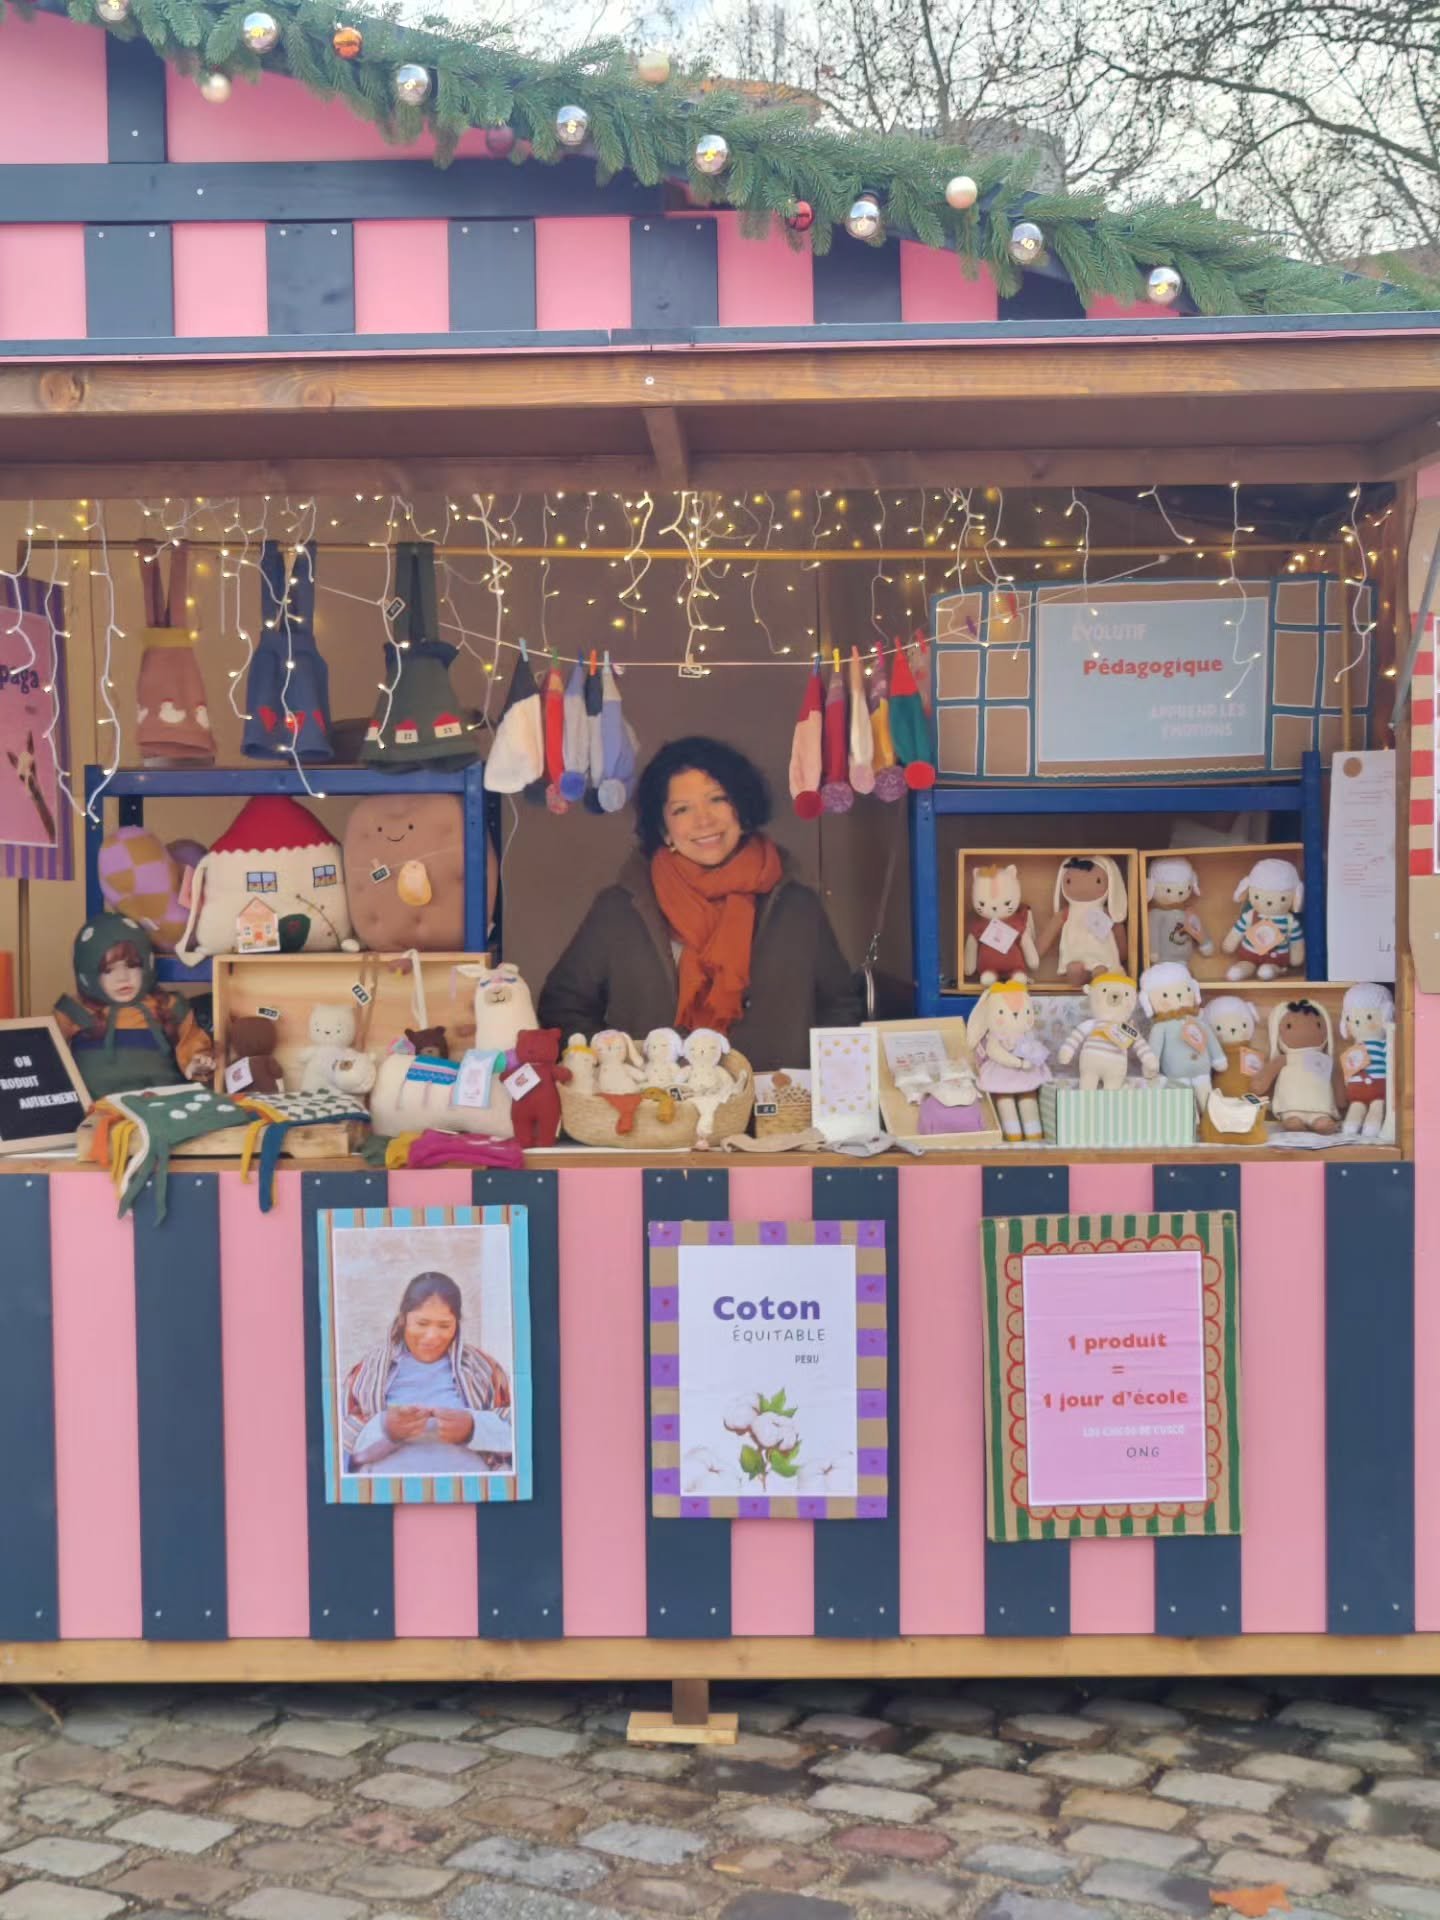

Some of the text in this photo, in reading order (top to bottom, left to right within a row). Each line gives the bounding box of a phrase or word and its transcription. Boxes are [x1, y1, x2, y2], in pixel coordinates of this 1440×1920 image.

[1083, 658, 1224, 679] Pédagogique
[14, 1056, 32, 1068] ON
[19, 1091, 78, 1110] AUTREMENT
[713, 1296, 820, 1320] Coton
[732, 1325, 825, 1342] ÉQUITABLE
[1068, 1332, 1167, 1354] 1 produit
[1043, 1394, 1052, 1409] 1
[1059, 1391, 1104, 1412] jour
[1126, 1446, 1160, 1458] ONG
